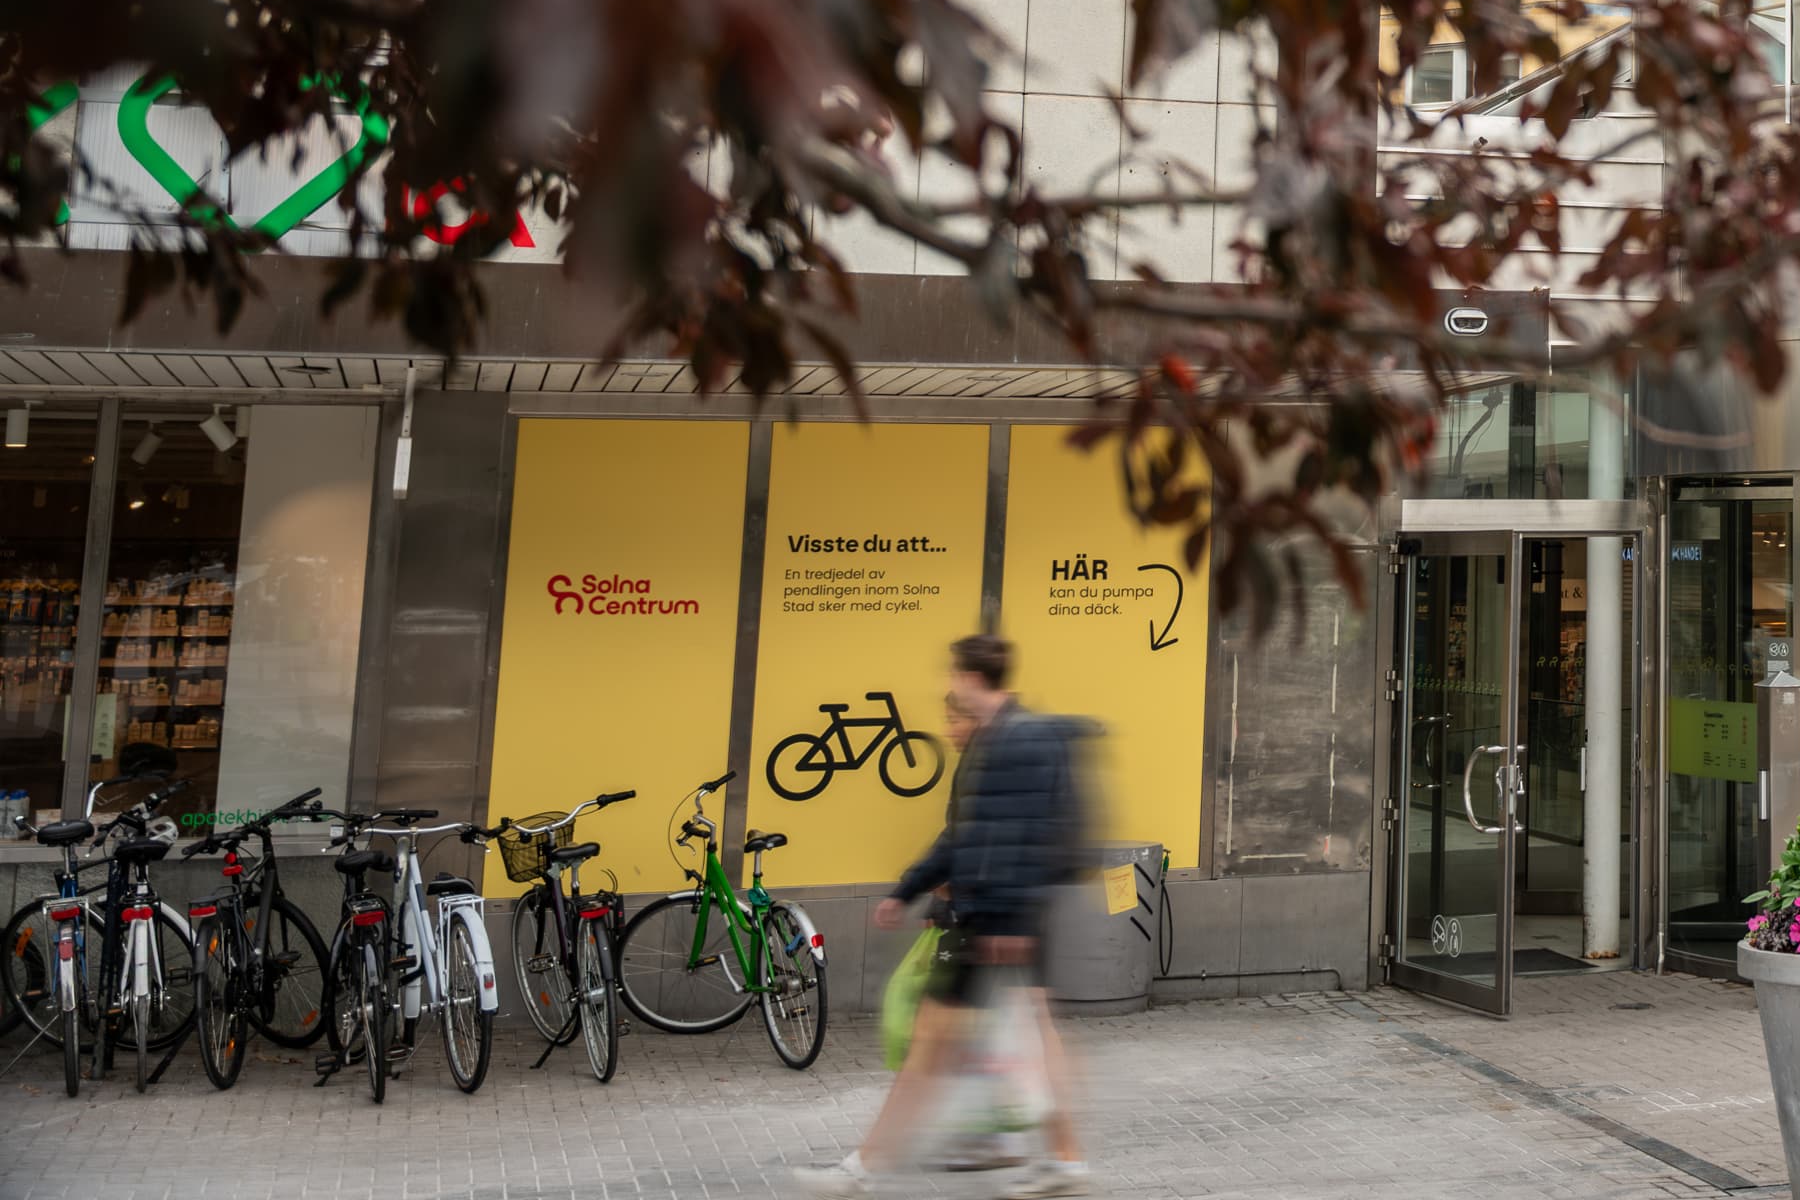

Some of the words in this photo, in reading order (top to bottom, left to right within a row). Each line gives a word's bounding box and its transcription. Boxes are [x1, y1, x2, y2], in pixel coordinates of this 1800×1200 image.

[787, 534, 859, 553] Visste
[863, 534, 892, 553] du
[896, 536, 947, 553] att...
[1052, 553, 1108, 581] HÄR
[784, 569, 800, 580] En
[804, 568, 865, 582] tredjedel
[868, 570, 886, 580] av
[581, 574, 651, 594] Solna
[783, 584, 861, 599] pendlingen
[865, 584, 899, 595] inom
[903, 584, 940, 595] Solna
[1049, 586, 1075, 598] kan
[1079, 586, 1098, 598] du
[1102, 586, 1154, 601] pumpa
[588, 595, 699, 615] Centrum
[783, 601, 814, 612] Stad
[818, 601, 847, 612] sker
[850, 600, 882, 611] med
[885, 600, 922, 614] cykel.
[1048, 604, 1080, 616] dina
[1084, 603, 1122, 615] däck.
